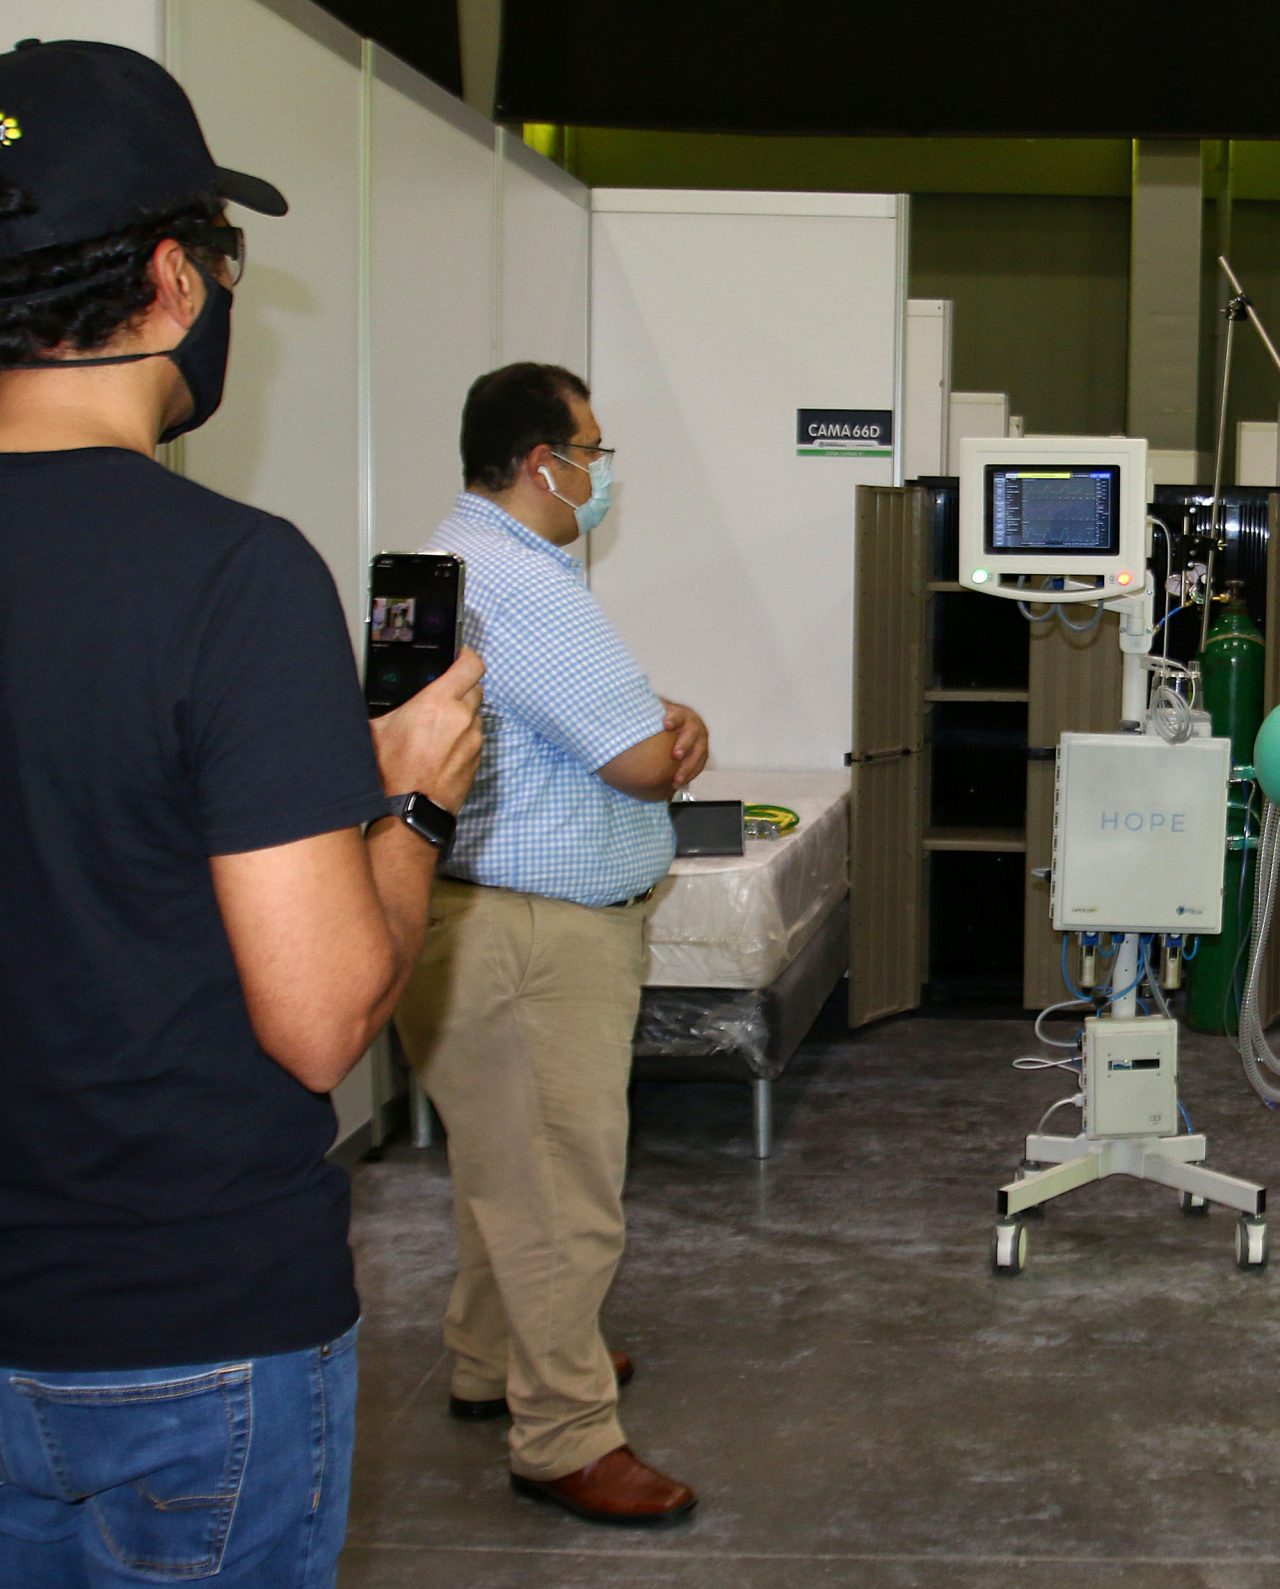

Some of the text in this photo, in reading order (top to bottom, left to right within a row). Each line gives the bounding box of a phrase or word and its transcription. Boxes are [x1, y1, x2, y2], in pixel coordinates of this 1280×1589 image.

[808, 424, 880, 438] CAMA 66D
[1101, 812, 1185, 832] HOPE
